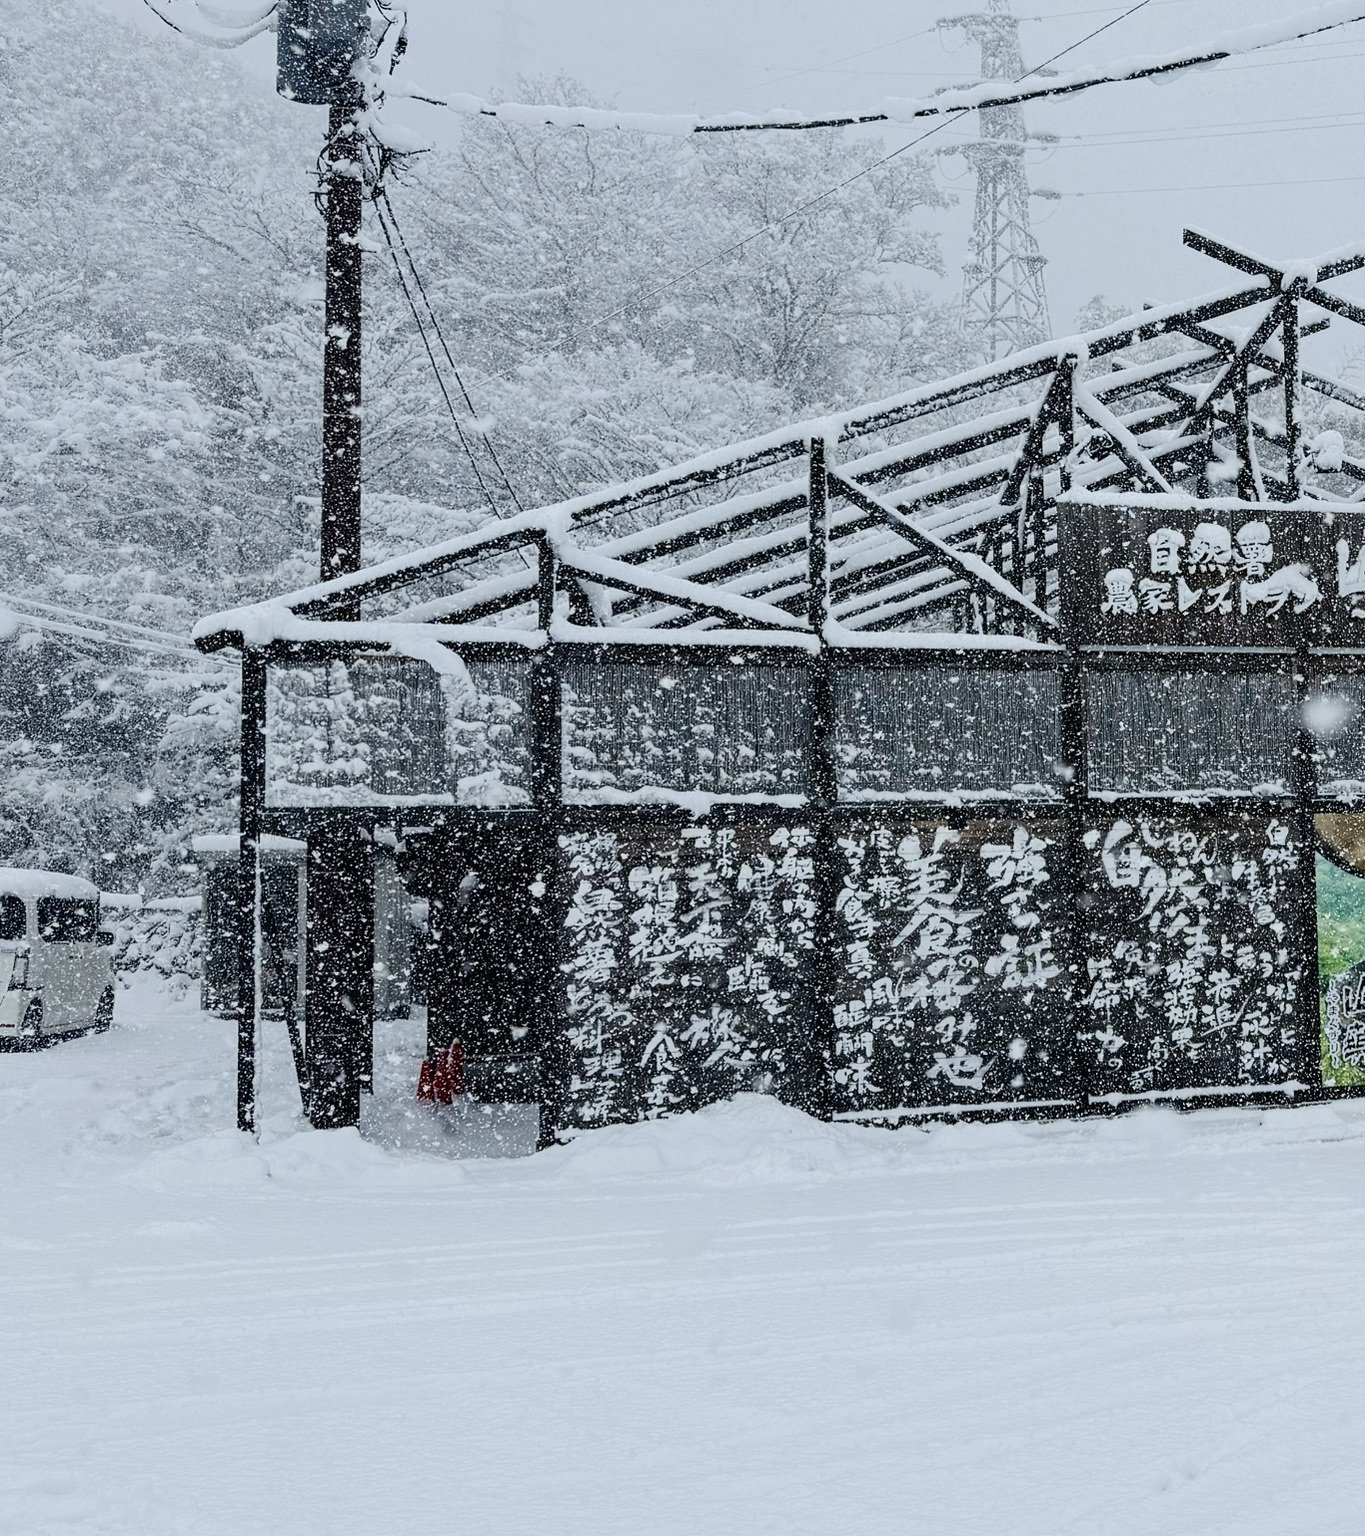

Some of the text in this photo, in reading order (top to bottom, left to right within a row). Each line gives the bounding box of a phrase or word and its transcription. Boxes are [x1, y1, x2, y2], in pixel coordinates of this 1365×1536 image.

[1148, 521, 1274, 576] 自然薯
[1102, 565, 1323, 616] 農家レストラン
